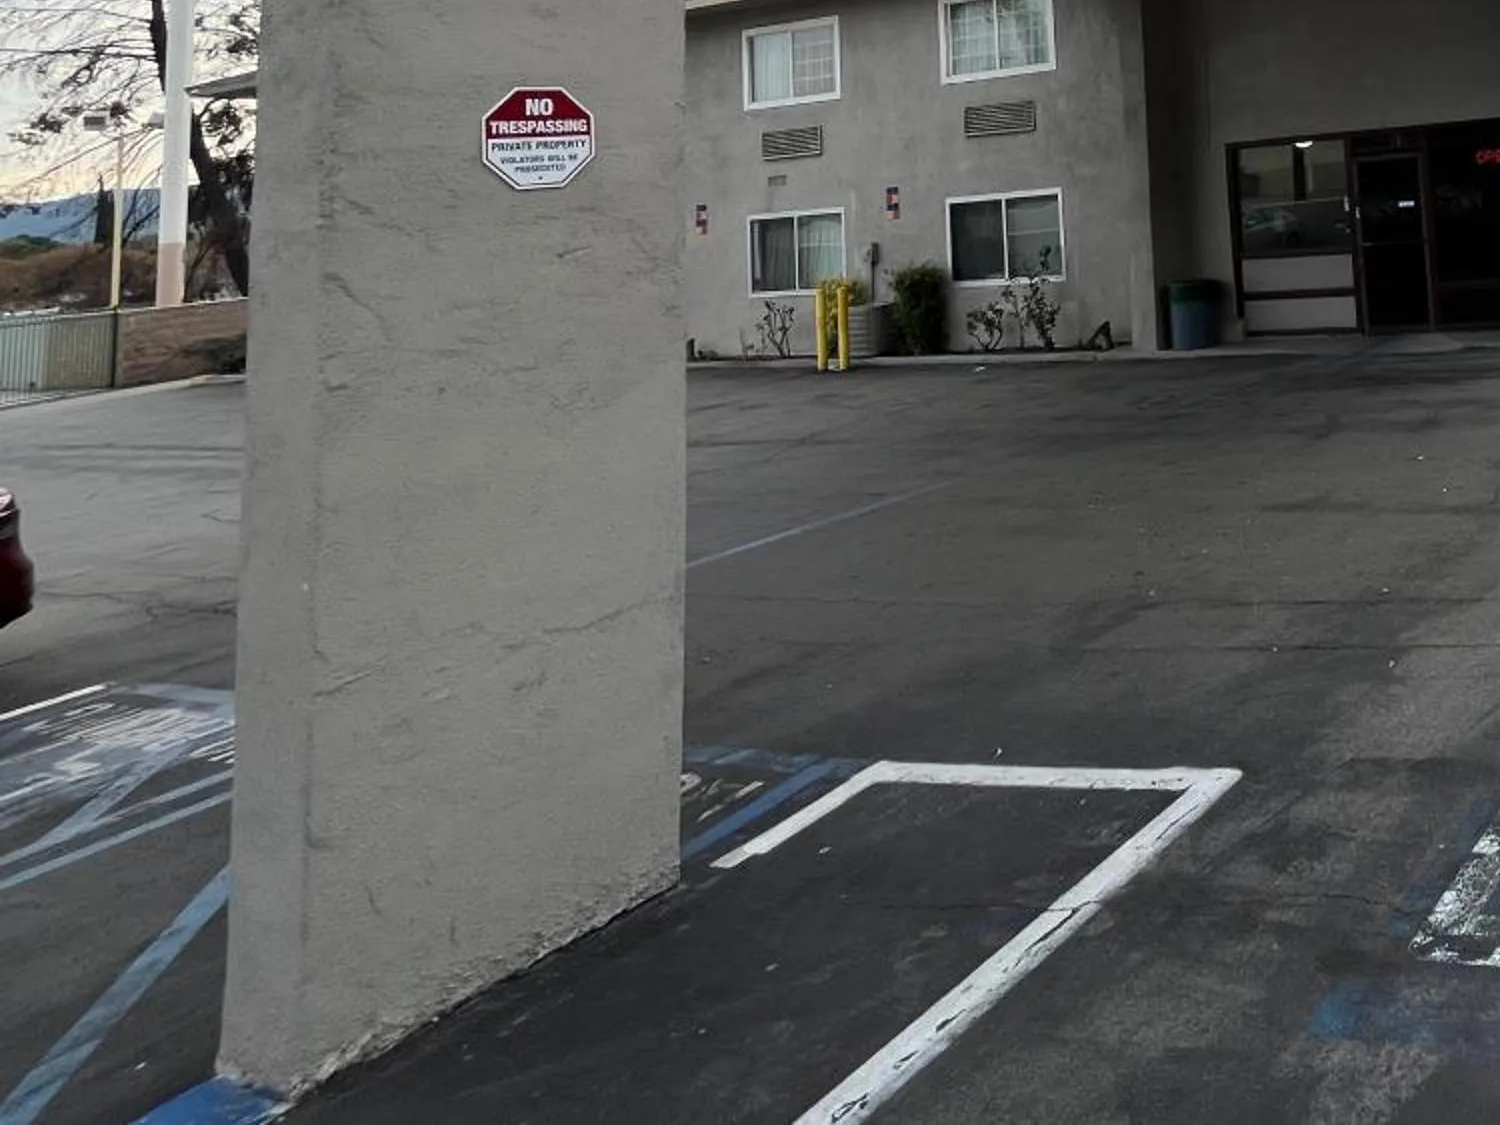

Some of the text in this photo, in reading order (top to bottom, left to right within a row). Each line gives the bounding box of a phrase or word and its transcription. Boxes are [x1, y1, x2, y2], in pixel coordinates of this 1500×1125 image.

[525, 98, 554, 116] NO
[489, 119, 587, 134] TRESPASSING
[491, 139, 586, 151] PRIVATE PROPERTY
